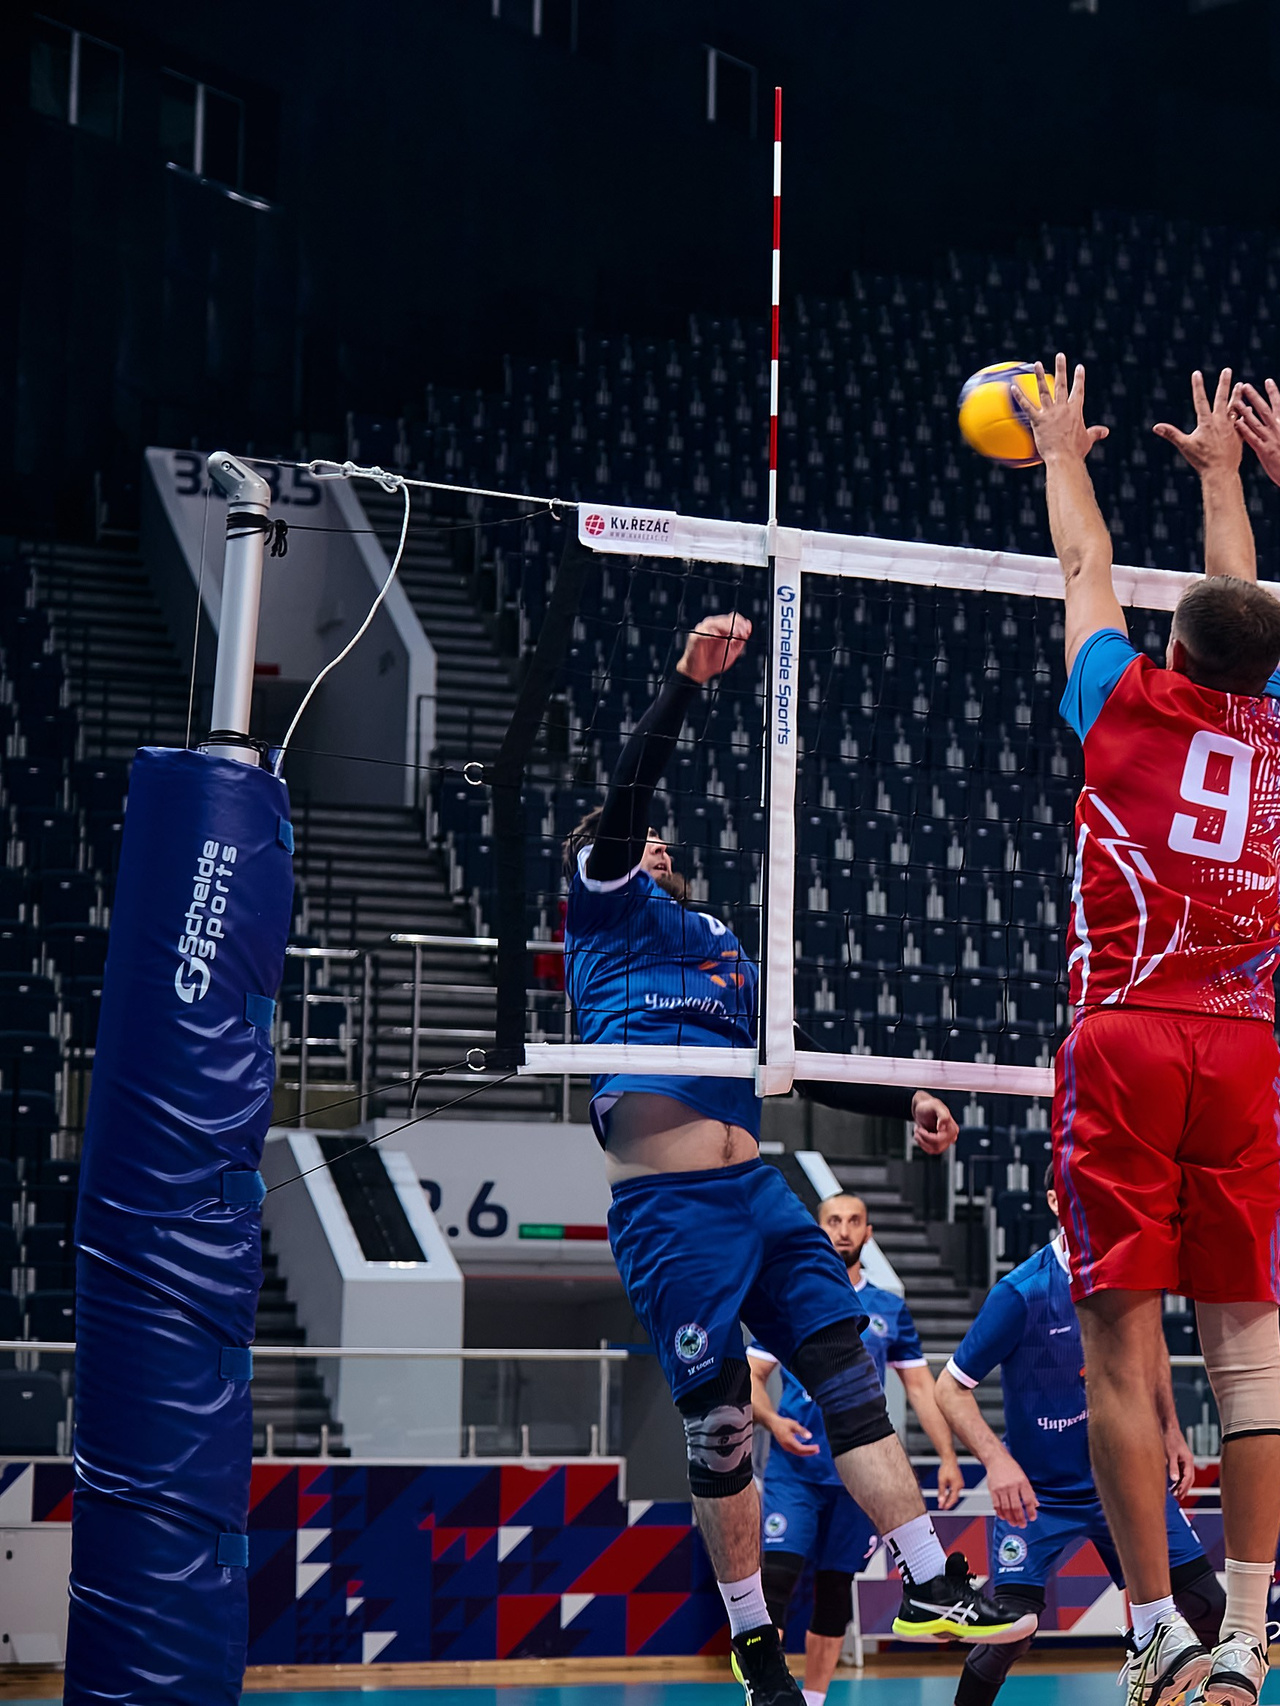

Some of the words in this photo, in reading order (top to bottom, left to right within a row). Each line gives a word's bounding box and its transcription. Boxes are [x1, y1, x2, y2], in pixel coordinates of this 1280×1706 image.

[779, 605, 794, 680] Schelde
[775, 684, 792, 745] Sports
[1167, 730, 1256, 862] 9
[178, 840, 220, 956] Schelde
[198, 845, 238, 960] Sports
